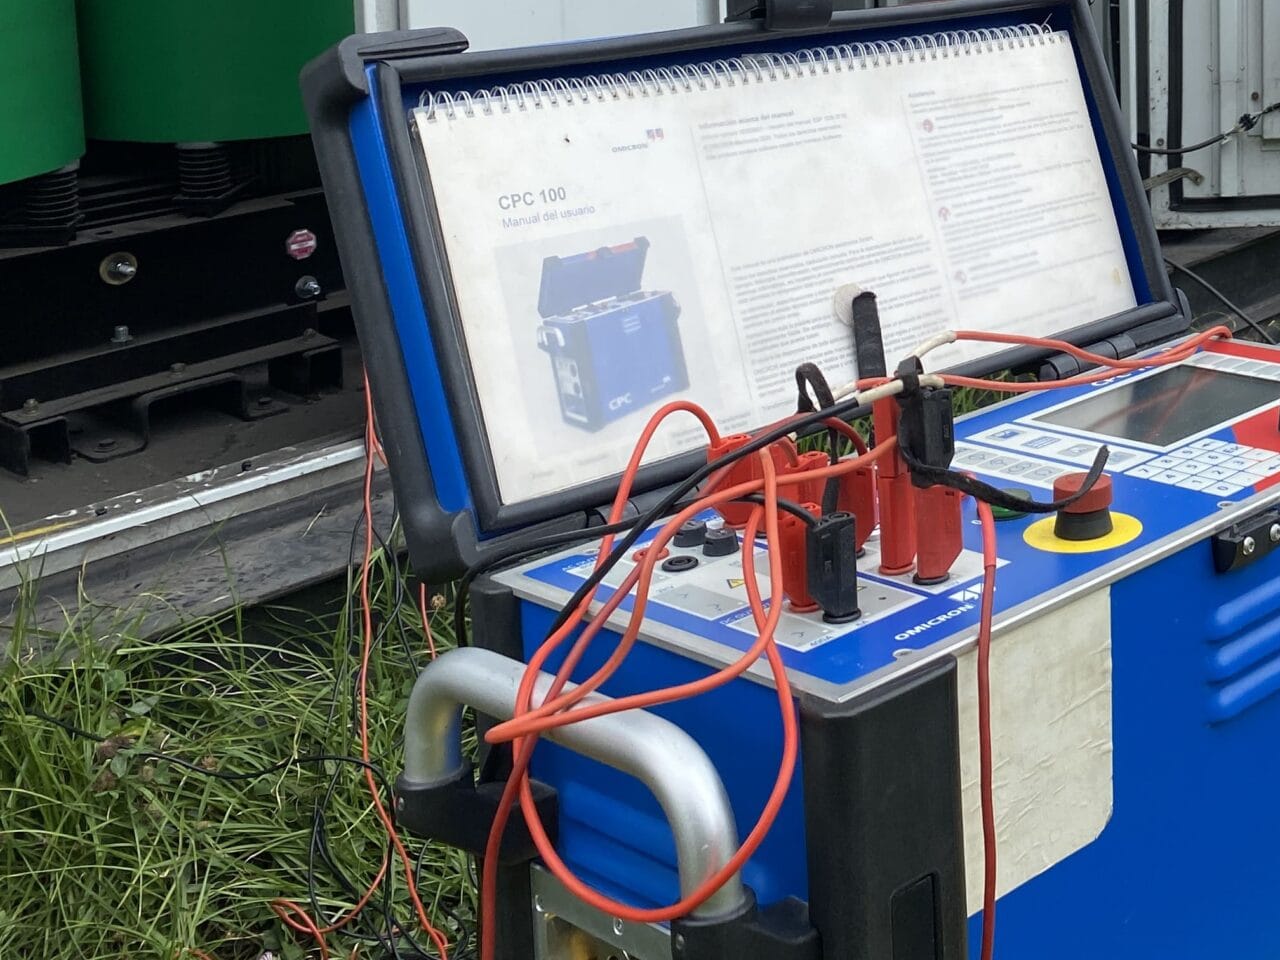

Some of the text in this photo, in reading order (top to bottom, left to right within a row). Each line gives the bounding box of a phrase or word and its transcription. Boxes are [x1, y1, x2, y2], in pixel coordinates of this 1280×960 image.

[498, 186, 567, 211] CPC 100
[502, 204, 597, 230] Manual del usuario
[608, 392, 633, 411] CPC
[893, 603, 976, 641] OMICRON
